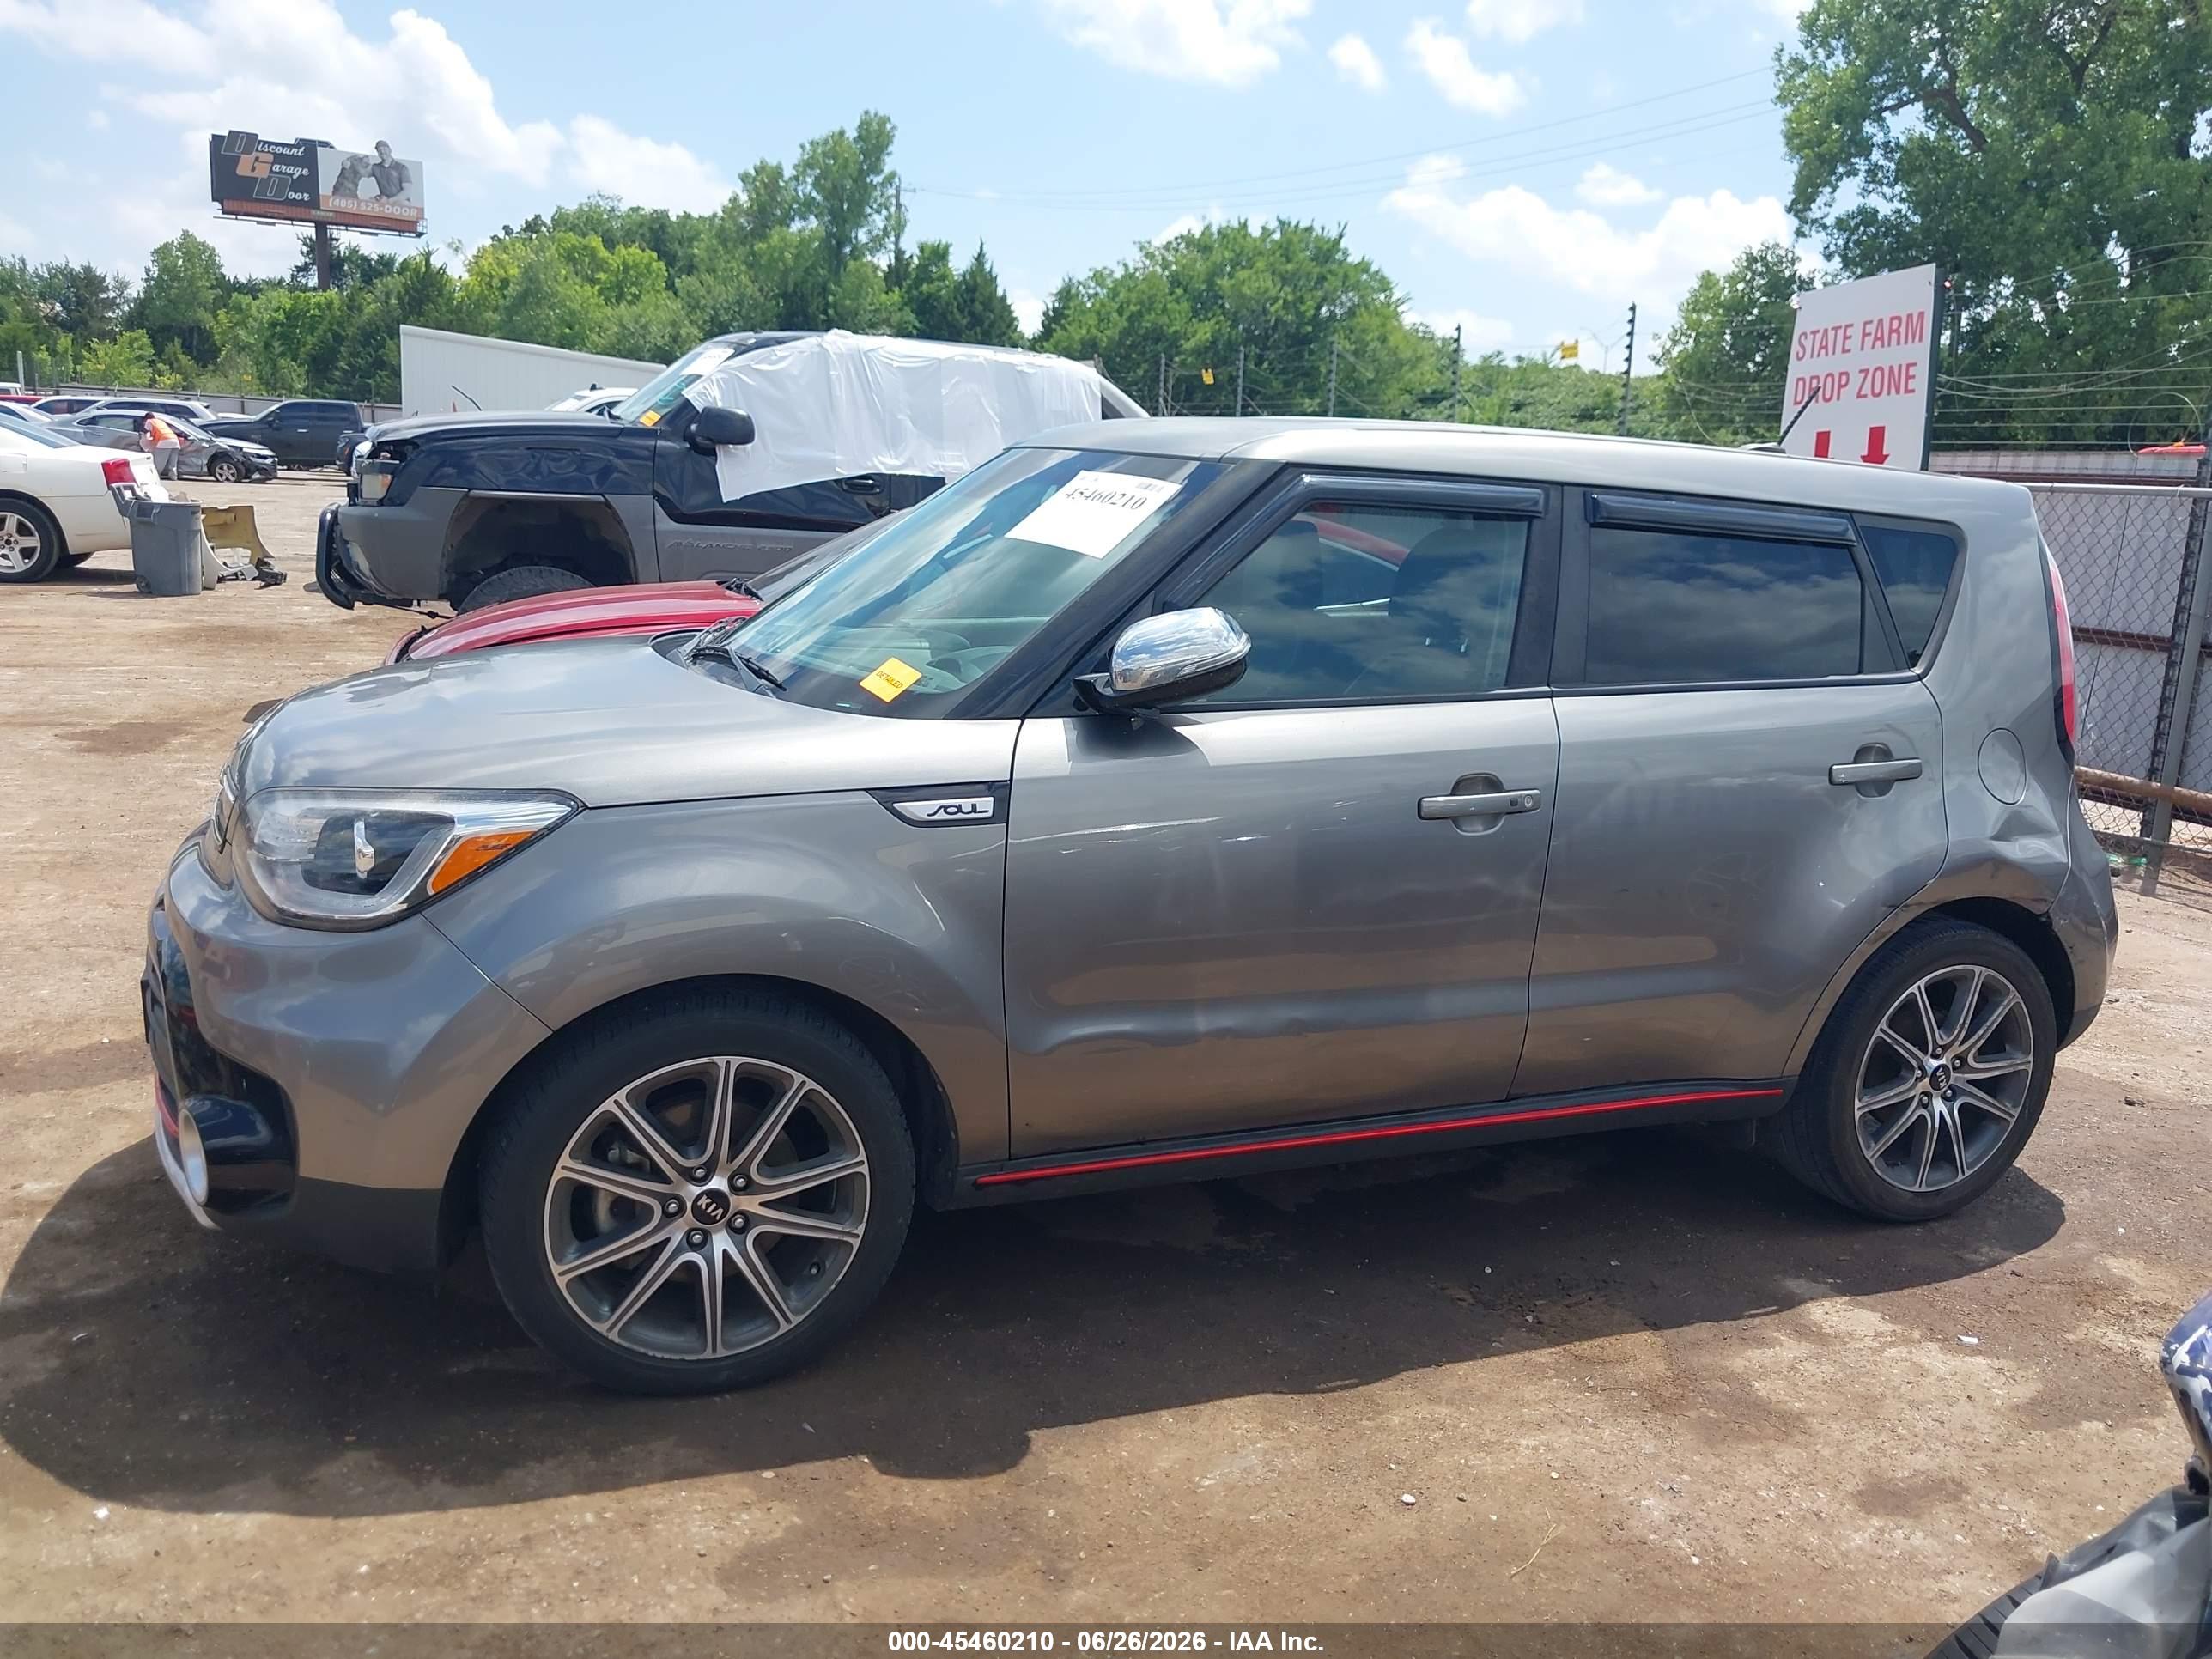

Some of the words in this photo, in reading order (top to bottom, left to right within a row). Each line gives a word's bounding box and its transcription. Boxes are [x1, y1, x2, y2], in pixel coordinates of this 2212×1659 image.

[221, 130, 305, 156] Discount
[236, 150, 310, 178] Garage
[253, 174, 311, 201] Door
[1796, 323, 1854, 362] STATE
[1860, 311, 1925, 351] FARM
[1793, 371, 1850, 406] DROP
[1856, 362, 1917, 399] ZONE
[927, 803, 989, 817] SOUL
[696, 1194, 724, 1220] KIA
